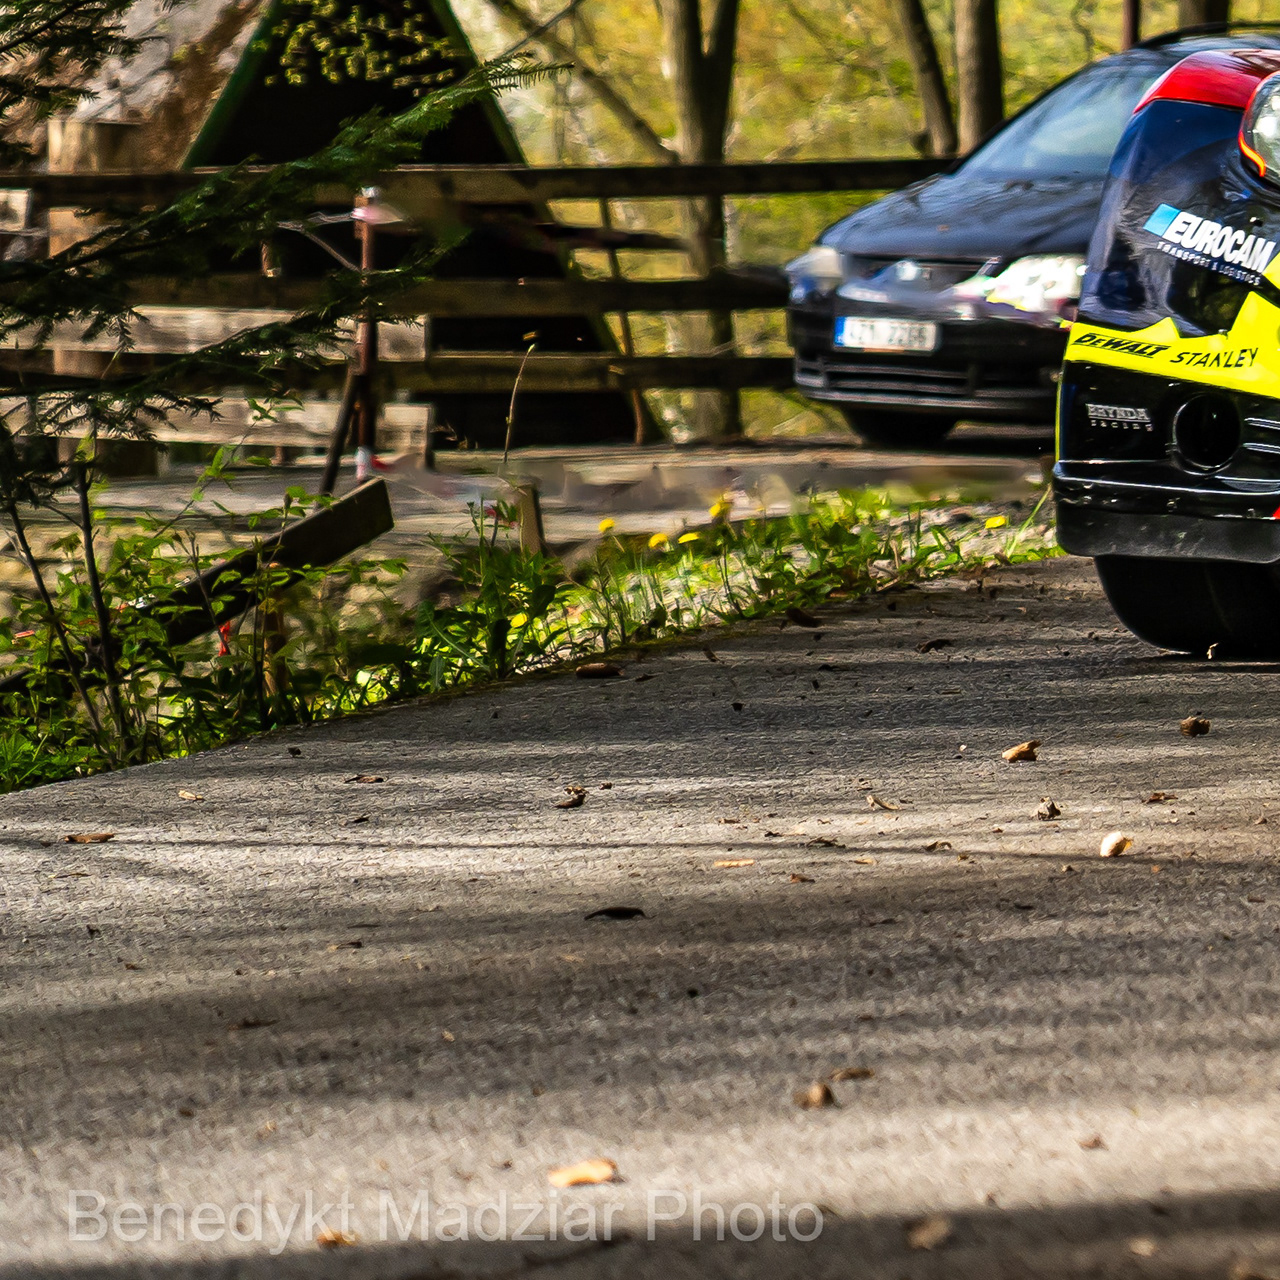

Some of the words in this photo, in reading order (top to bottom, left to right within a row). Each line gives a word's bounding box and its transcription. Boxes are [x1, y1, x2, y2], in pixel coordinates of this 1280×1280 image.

[1156, 241, 1212, 269] TRANSPORT
[1162, 211, 1277, 273] EUROCAM
[1170, 347, 1259, 368] STANLEY
